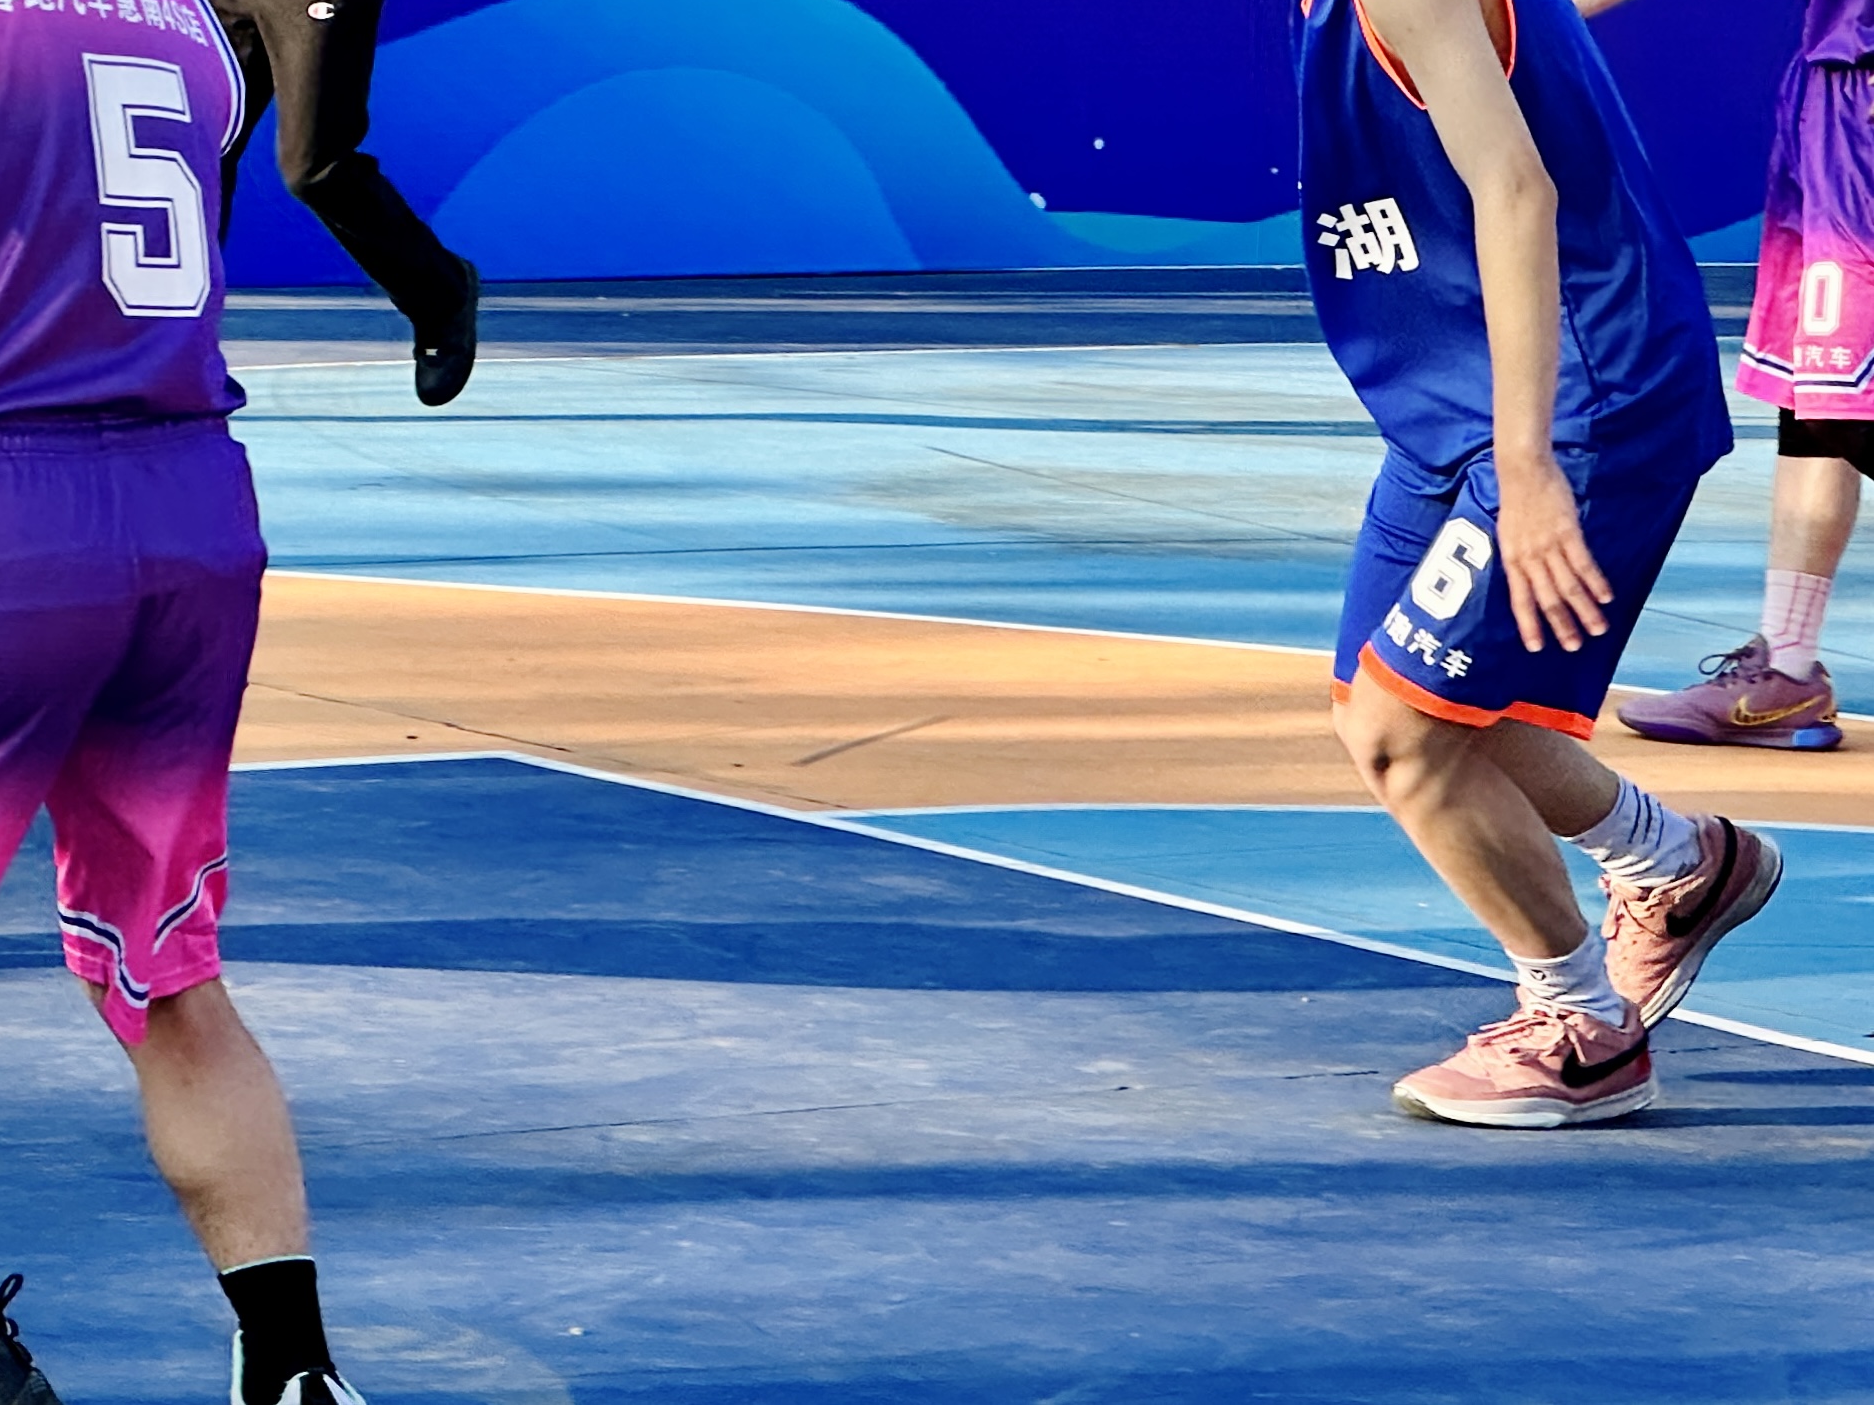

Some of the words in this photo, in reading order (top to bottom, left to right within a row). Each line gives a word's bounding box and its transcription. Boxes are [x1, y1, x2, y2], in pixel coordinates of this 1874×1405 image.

[82, 53, 211, 318] 5
[1317, 197, 1420, 280] 湖
[1793, 345, 1852, 370] 汽车
[1410, 517, 1493, 620] 6
